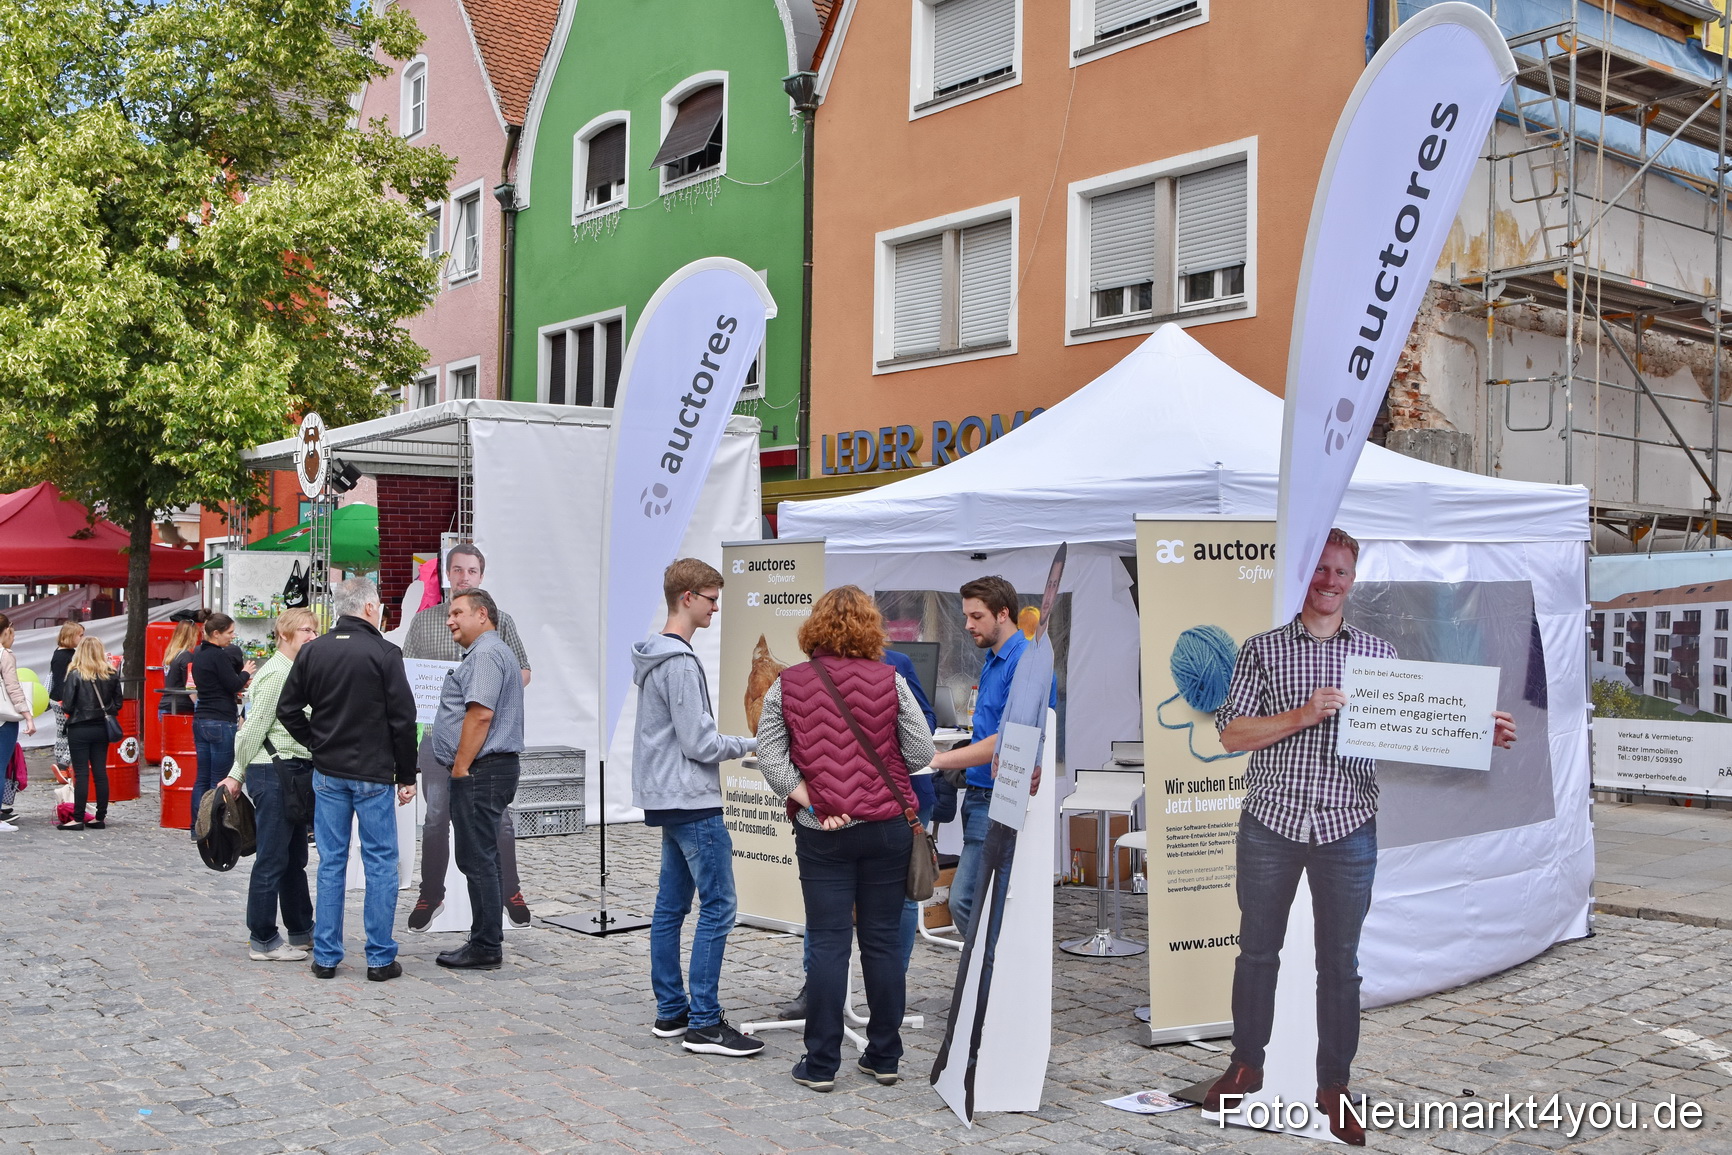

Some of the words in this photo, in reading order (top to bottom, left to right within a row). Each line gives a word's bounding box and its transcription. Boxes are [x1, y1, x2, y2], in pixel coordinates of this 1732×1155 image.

[1348, 102, 1459, 381] auctores
[660, 314, 738, 474] auctores
[821, 424, 923, 475] LEDER
[748, 558, 796, 571] auctores
[768, 573, 796, 585] Software
[763, 591, 813, 605] auctores
[1352, 668, 1363, 676] Ich
[1390, 671, 1424, 680] Auctores:
[1350, 687, 1379, 700] „Weil
[1382, 692, 1394, 701] es
[1397, 691, 1425, 704] Spaß
[1427, 695, 1467, 708] macht,
[1349, 703, 1359, 713] in
[1362, 704, 1397, 717] einem
[1399, 709, 1467, 723] engagierten
[1348, 718, 1377, 730] Team
[1380, 722, 1413, 734] etwas
[1415, 727, 1428, 735] zu
[1431, 725, 1488, 740] schaffen.“
[1618, 731, 1643, 740] Verkauf
[1651, 733, 1694, 743] Vermietung:
[1345, 738, 1376, 748] Andreas,
[1378, 741, 1412, 752] Beratung
[1412, 744, 1420, 752] &
[1421, 745, 1450, 755] Vertrieb
[1617, 745, 1639, 753] Rätzer
[1640, 746, 1679, 755] Immobilien
[726, 775, 738, 788] Wir
[739, 776, 762, 791] können
[1617, 771, 1687, 782] www.gerberhoefe.de
[1165, 778, 1184, 795] Wir
[1187, 776, 1225, 794] suchen
[726, 790, 763, 805] Individuelle
[725, 804, 741, 818] alles
[741, 808, 757, 820] rund
[758, 811, 769, 821] um
[1165, 797, 1192, 814] Jetzt
[725, 820, 738, 832] und
[738, 821, 778, 837] Crossmedia.
[1183, 822, 1234, 831] Software-Entwickler
[1166, 831, 1217, 841] Software-Entwickler
[1166, 850, 1207, 858] Web-Entwickler
[1207, 848, 1224, 856] (m/w)
[1167, 882, 1231, 893] bewerbung@auctores.de
